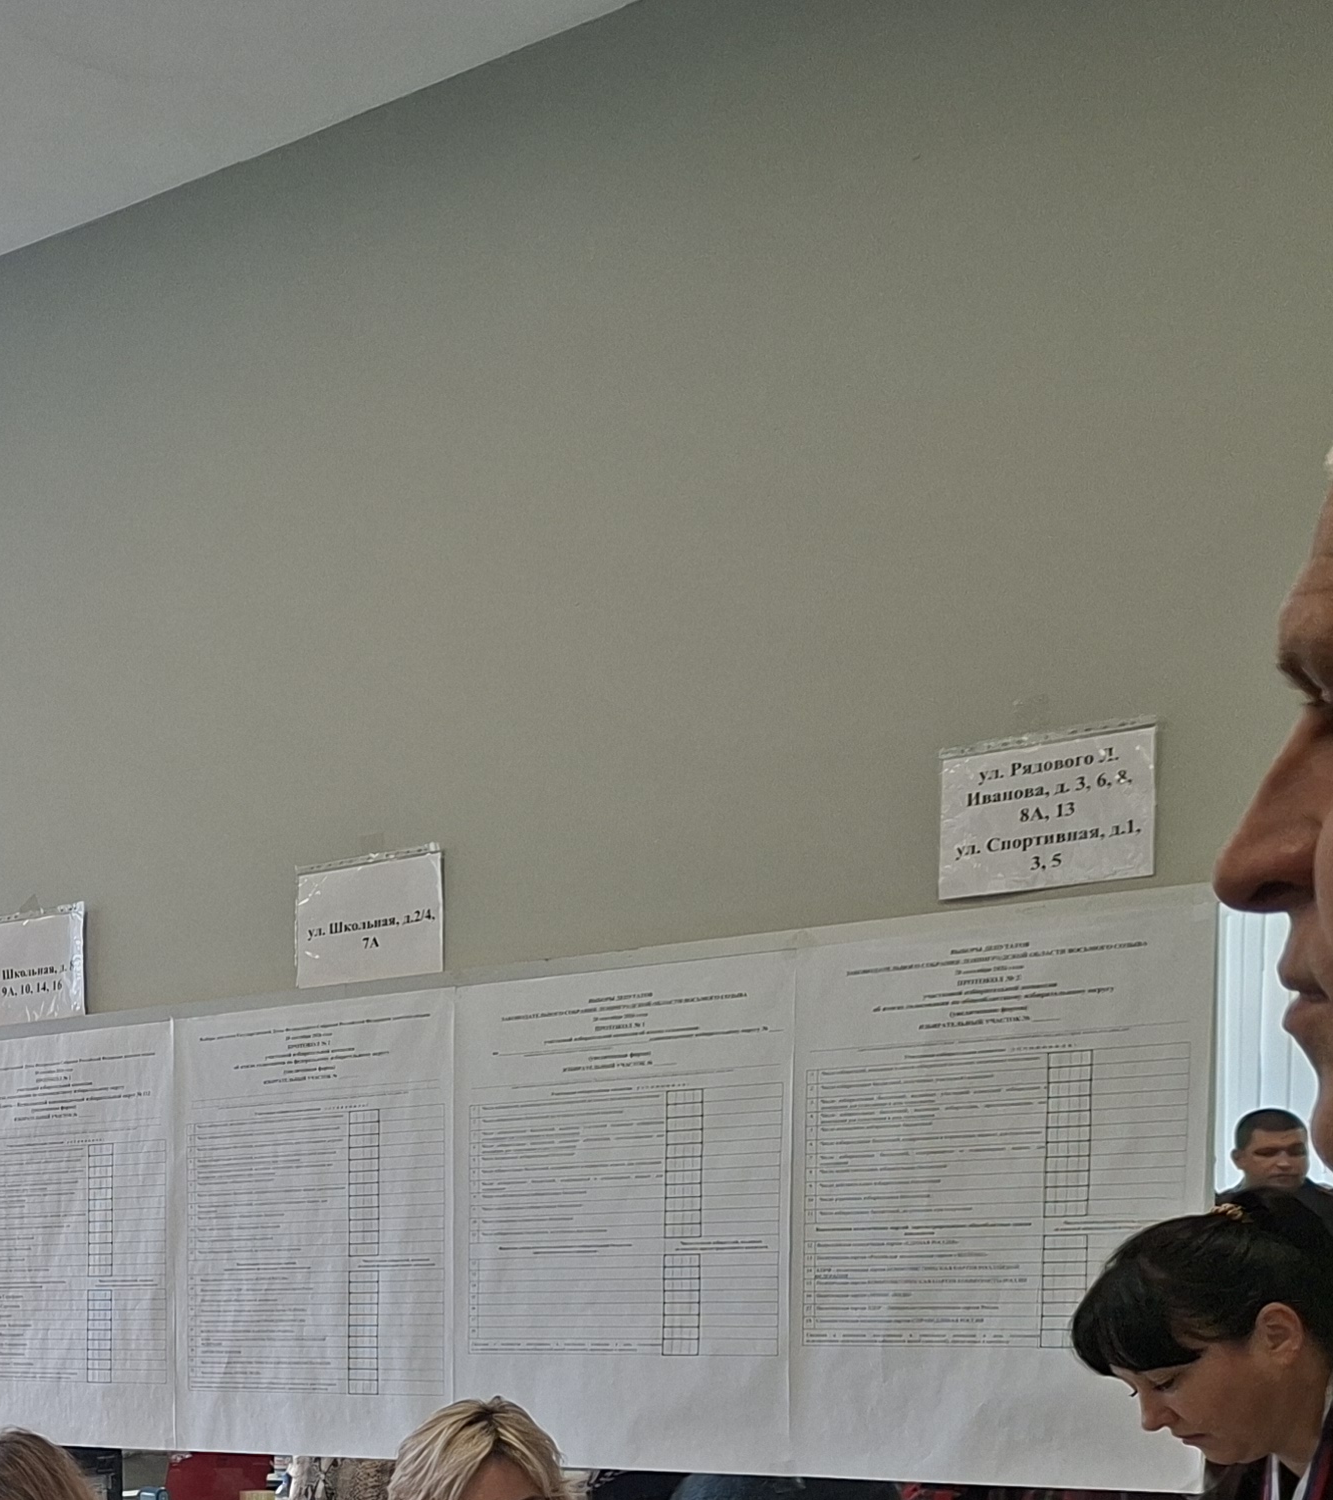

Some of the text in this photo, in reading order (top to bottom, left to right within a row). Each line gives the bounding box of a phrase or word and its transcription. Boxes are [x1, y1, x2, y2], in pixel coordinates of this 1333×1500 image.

[978, 769, 1004, 785] ул.
[1010, 754, 1094, 777] Рядового
[966, 782, 1050, 807] Иванова,
[1053, 782, 1071, 796] д.
[1075, 776, 1092, 792] 3,
[1096, 772, 1112, 788] 6,
[1056, 801, 1075, 818] 13
[955, 843, 981, 860] ул.
[986, 824, 1105, 854] Спортивная,
[1030, 853, 1062, 871] 3, 5
[307, 928, 326, 941] ул.
[329, 917, 400, 935] Школьная,
[2, 965, 58, 980] Школьная,
[53, 979, 63, 991] 16
